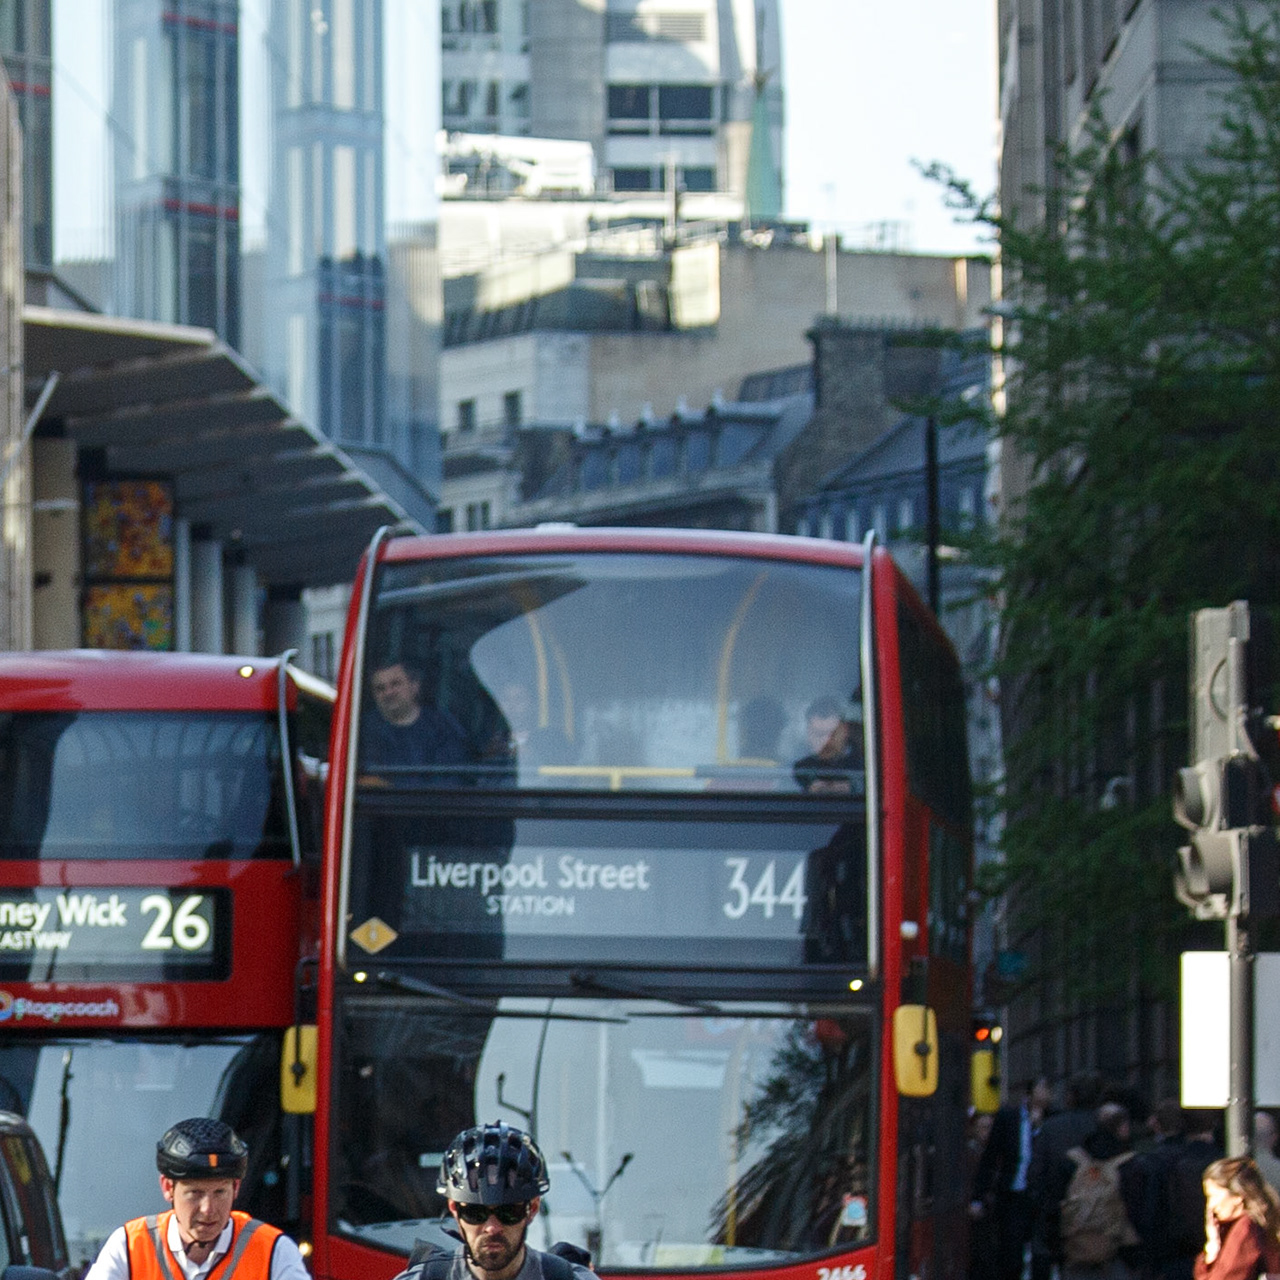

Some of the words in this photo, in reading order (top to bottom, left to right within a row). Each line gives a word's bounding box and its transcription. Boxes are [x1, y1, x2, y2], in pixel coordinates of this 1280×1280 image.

[412, 854, 547, 895] Liverpool
[557, 854, 649, 890] Street
[724, 857, 808, 919] 344
[56, 894, 128, 927] Wick
[140, 894, 210, 950] 26
[486, 896, 574, 915] STATION
